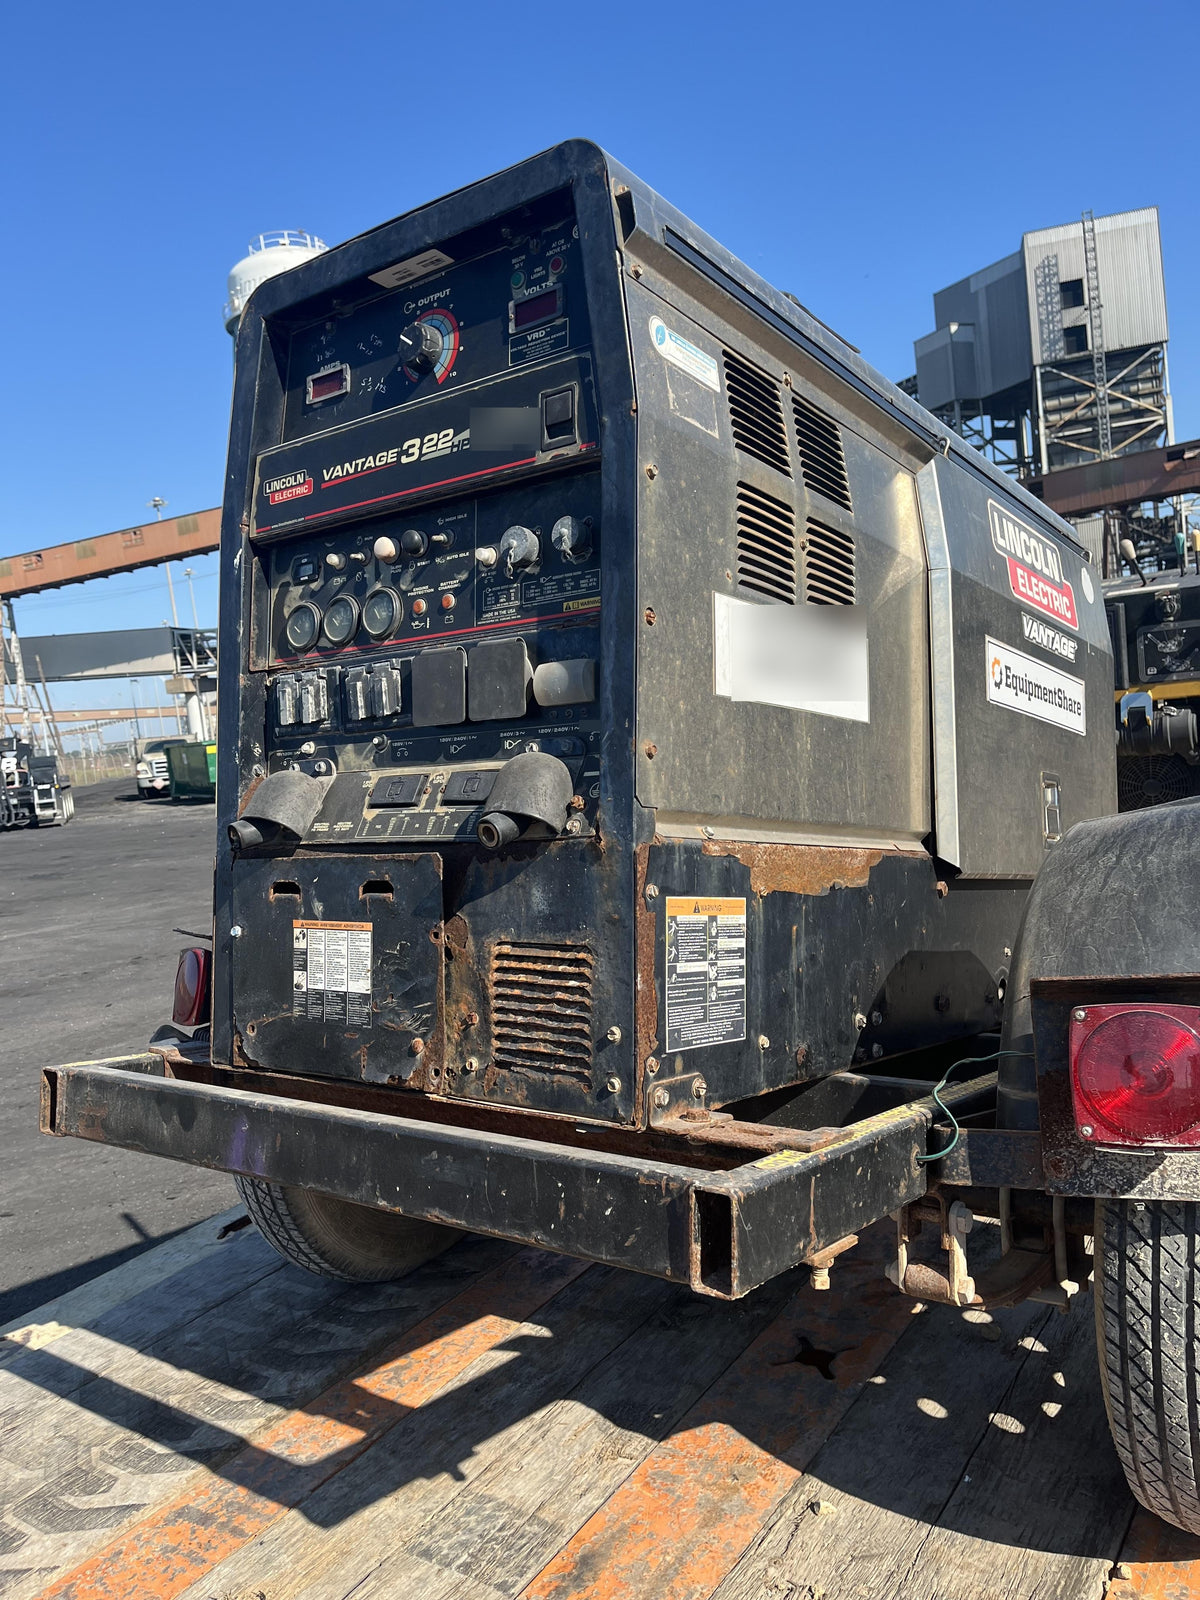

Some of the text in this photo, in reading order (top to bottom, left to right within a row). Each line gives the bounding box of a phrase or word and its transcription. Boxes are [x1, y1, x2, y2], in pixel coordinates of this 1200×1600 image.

[417, 288, 451, 307] OUTPUT
[524, 280, 554, 296] VOLTS
[320, 360, 341, 373] AMPS
[322, 448, 397, 481] VANTAGE
[401, 428, 454, 464] 322
[266, 472, 305, 494] LINCOLN
[274, 485, 308, 502] ELECTRIC
[993, 511, 1061, 583] LINCOLN
[407, 588, 435, 597] PROTECTION
[1015, 567, 1072, 619] ELECTRIC
[1022, 614, 1076, 660] VANTAGE
[1004, 664, 1082, 717] EquipmentShare
[701, 904, 722, 912] WARNING
